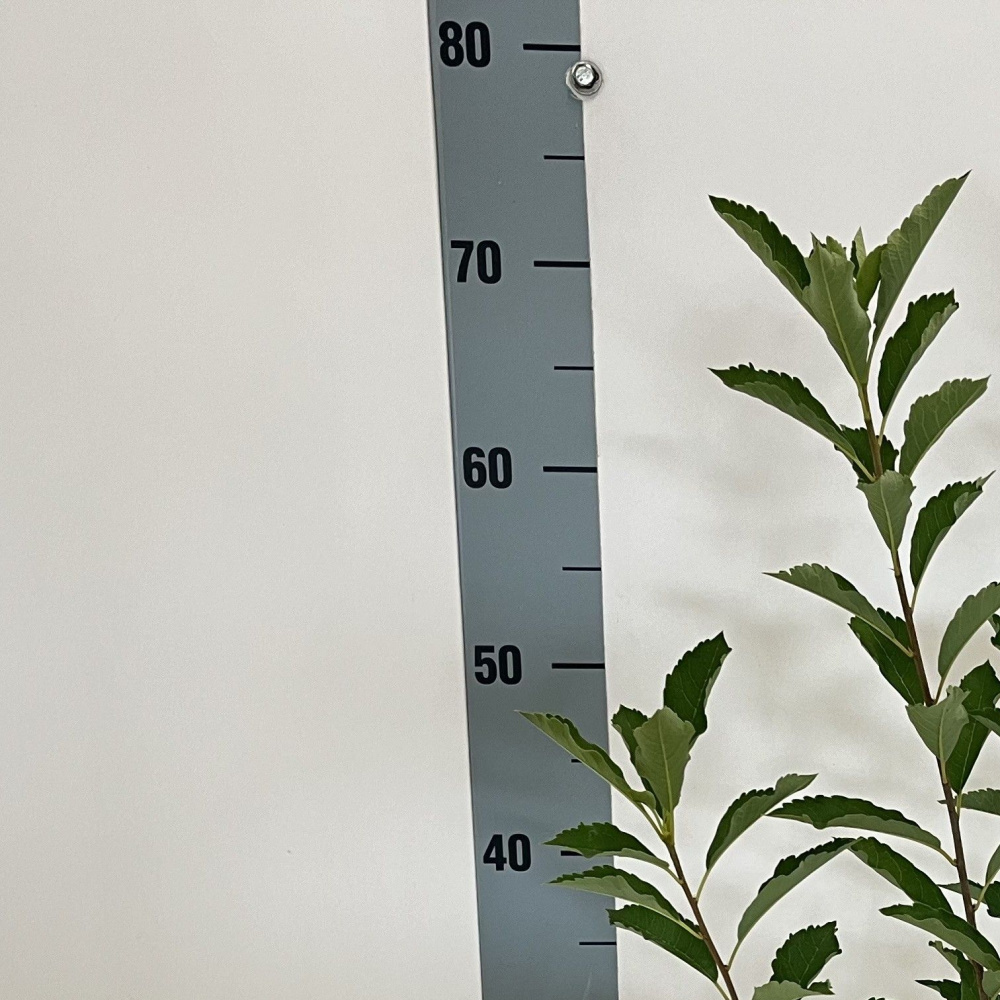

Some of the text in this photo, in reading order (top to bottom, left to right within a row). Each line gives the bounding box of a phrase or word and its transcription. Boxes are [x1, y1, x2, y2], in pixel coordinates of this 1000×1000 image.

[438, 20, 491, 68] 80
[450, 239, 502, 285] 70
[462, 446, 513, 489] 60
[474, 644, 523, 686] 50
[482, 833, 532, 872] 40
